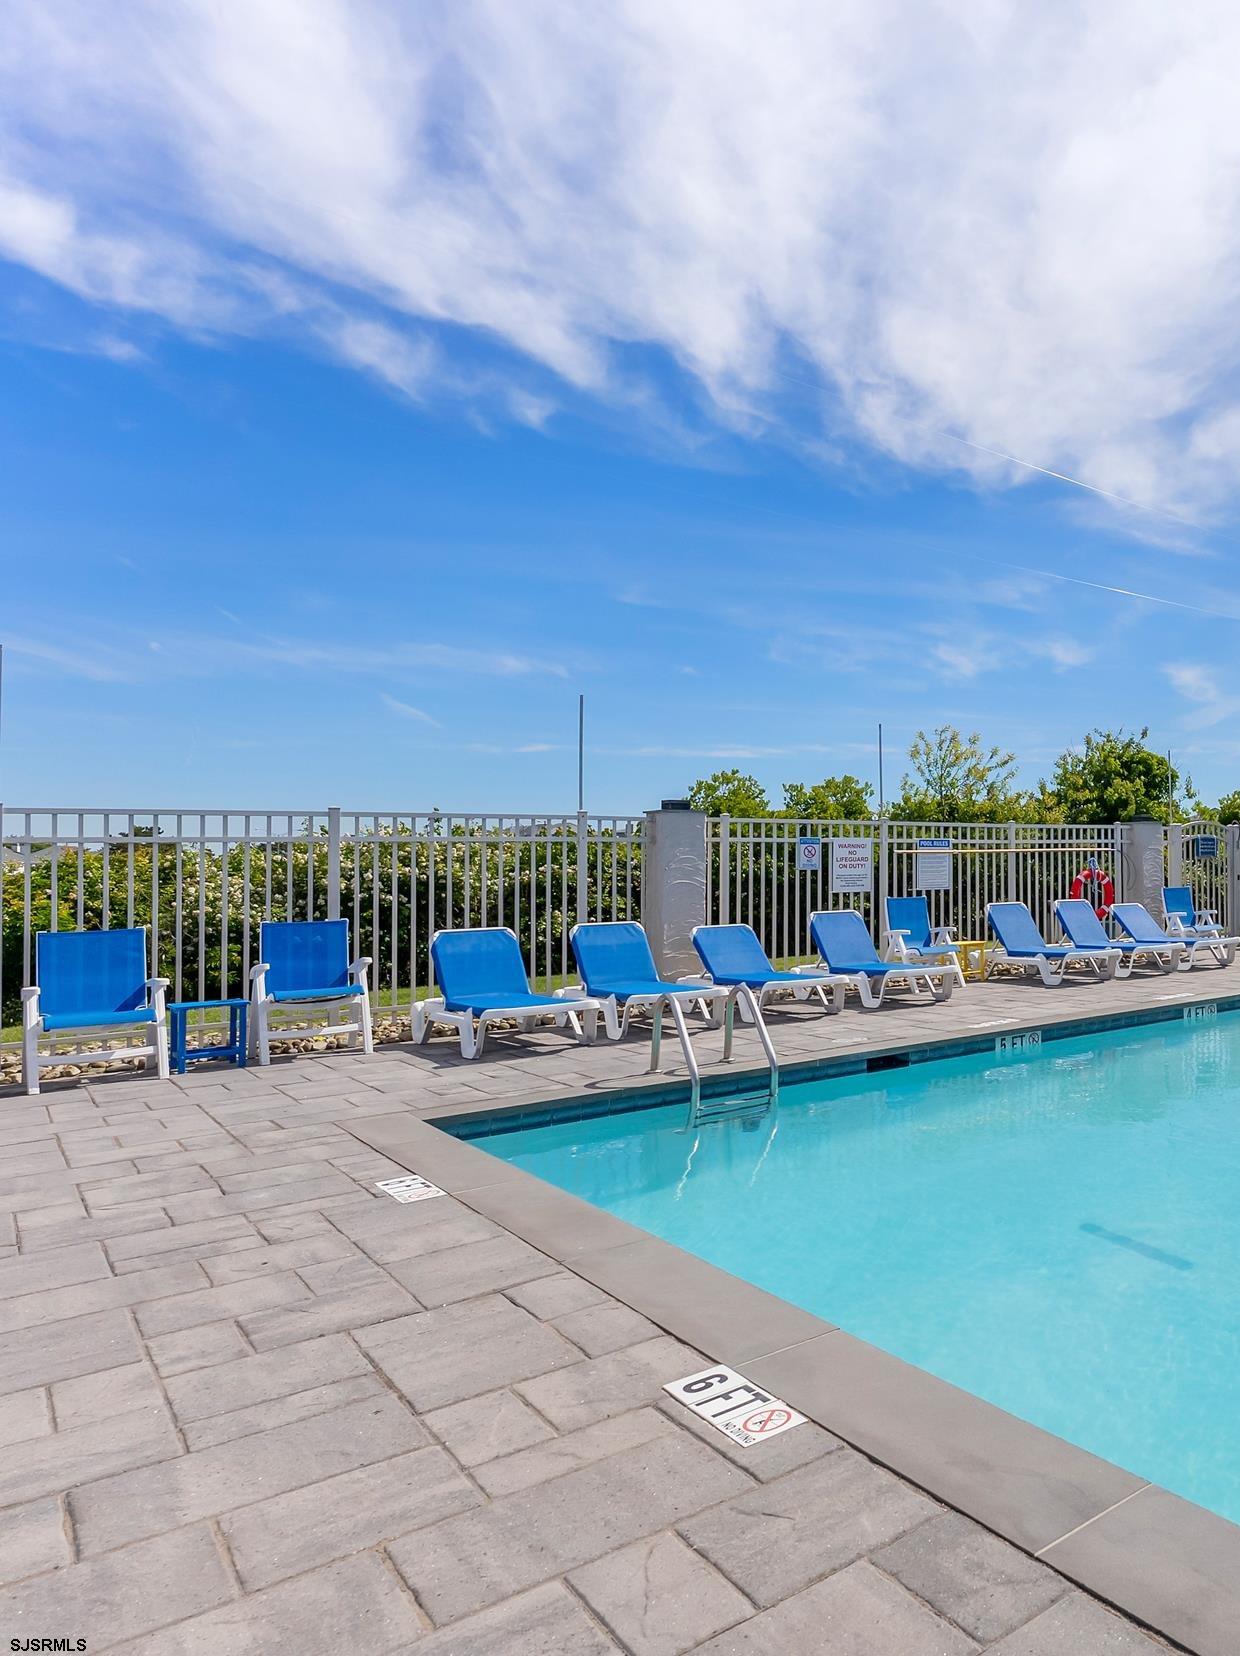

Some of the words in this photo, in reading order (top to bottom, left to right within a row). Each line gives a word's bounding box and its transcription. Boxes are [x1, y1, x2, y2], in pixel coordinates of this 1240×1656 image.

[1195, 1006, 1206, 1017] FT
[1000, 1037, 1007, 1049] 5
[1012, 1034, 1026, 1049] FT
[682, 1373, 729, 1394] 6
[694, 1384, 772, 1419] FT
[720, 1421, 736, 1432] NO
